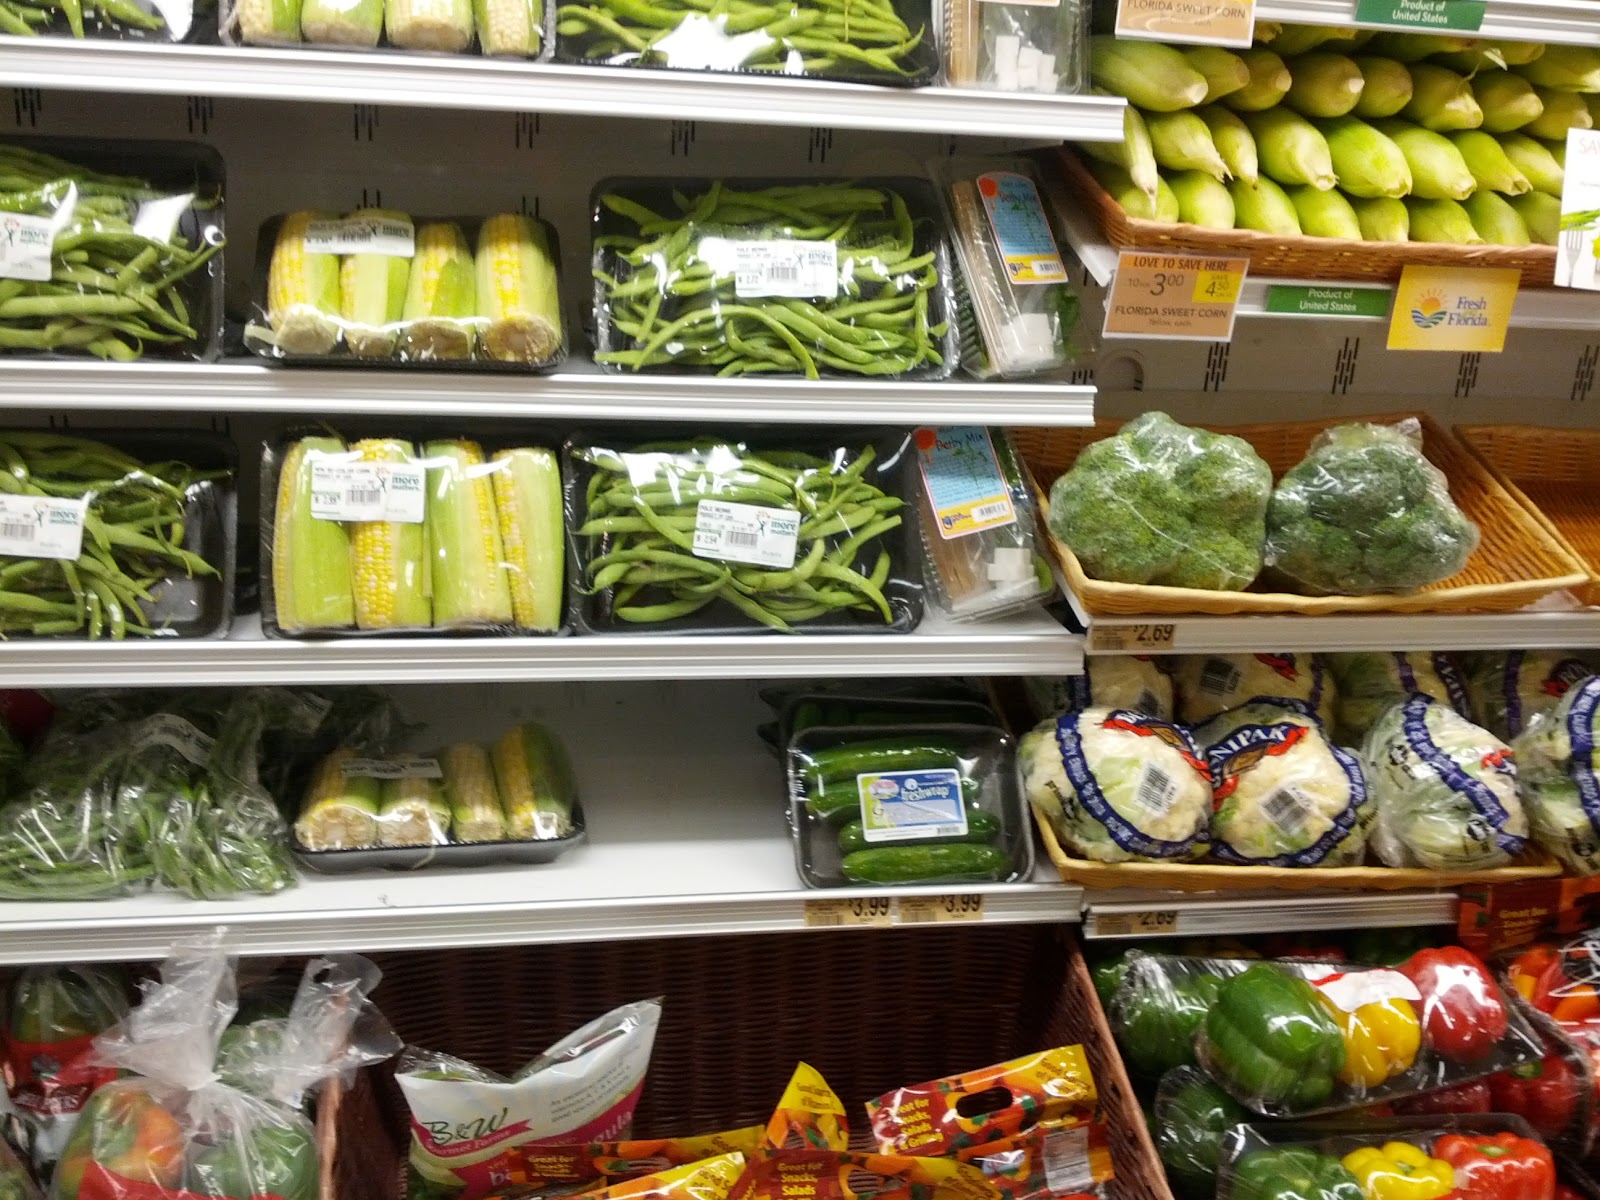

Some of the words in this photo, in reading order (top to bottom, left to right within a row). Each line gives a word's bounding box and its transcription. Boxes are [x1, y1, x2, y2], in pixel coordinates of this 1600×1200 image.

[1127, 0, 1173, 11] FLORIDA
[1176, 4, 1211, 15] SWEET
[1215, 7, 1246, 19] CORN
[1401, 0, 1434, 11] Product
[1435, 1, 1446, 12] of
[1392, 9, 1421, 22] United
[1421, 11, 1448, 24] States
[1133, 256, 1159, 269] LOVE
[1163, 257, 1176, 269] TO
[1179, 258, 1203, 270] SAVE
[1204, 260, 1230, 272] HERE
[1308, 288, 1342, 300] Product
[1343, 289, 1354, 300] of
[1299, 300, 1329, 312] United
[1329, 301, 1357, 312] States
[1456, 296, 1488, 311] Fresh
[1114, 305, 1159, 316] FLORIDA
[1161, 307, 1195, 318] SWEET
[1198, 309, 1229, 319] CORN
[1447, 313, 1488, 327] Florida
[781, 1184, 817, 1196] Salads
